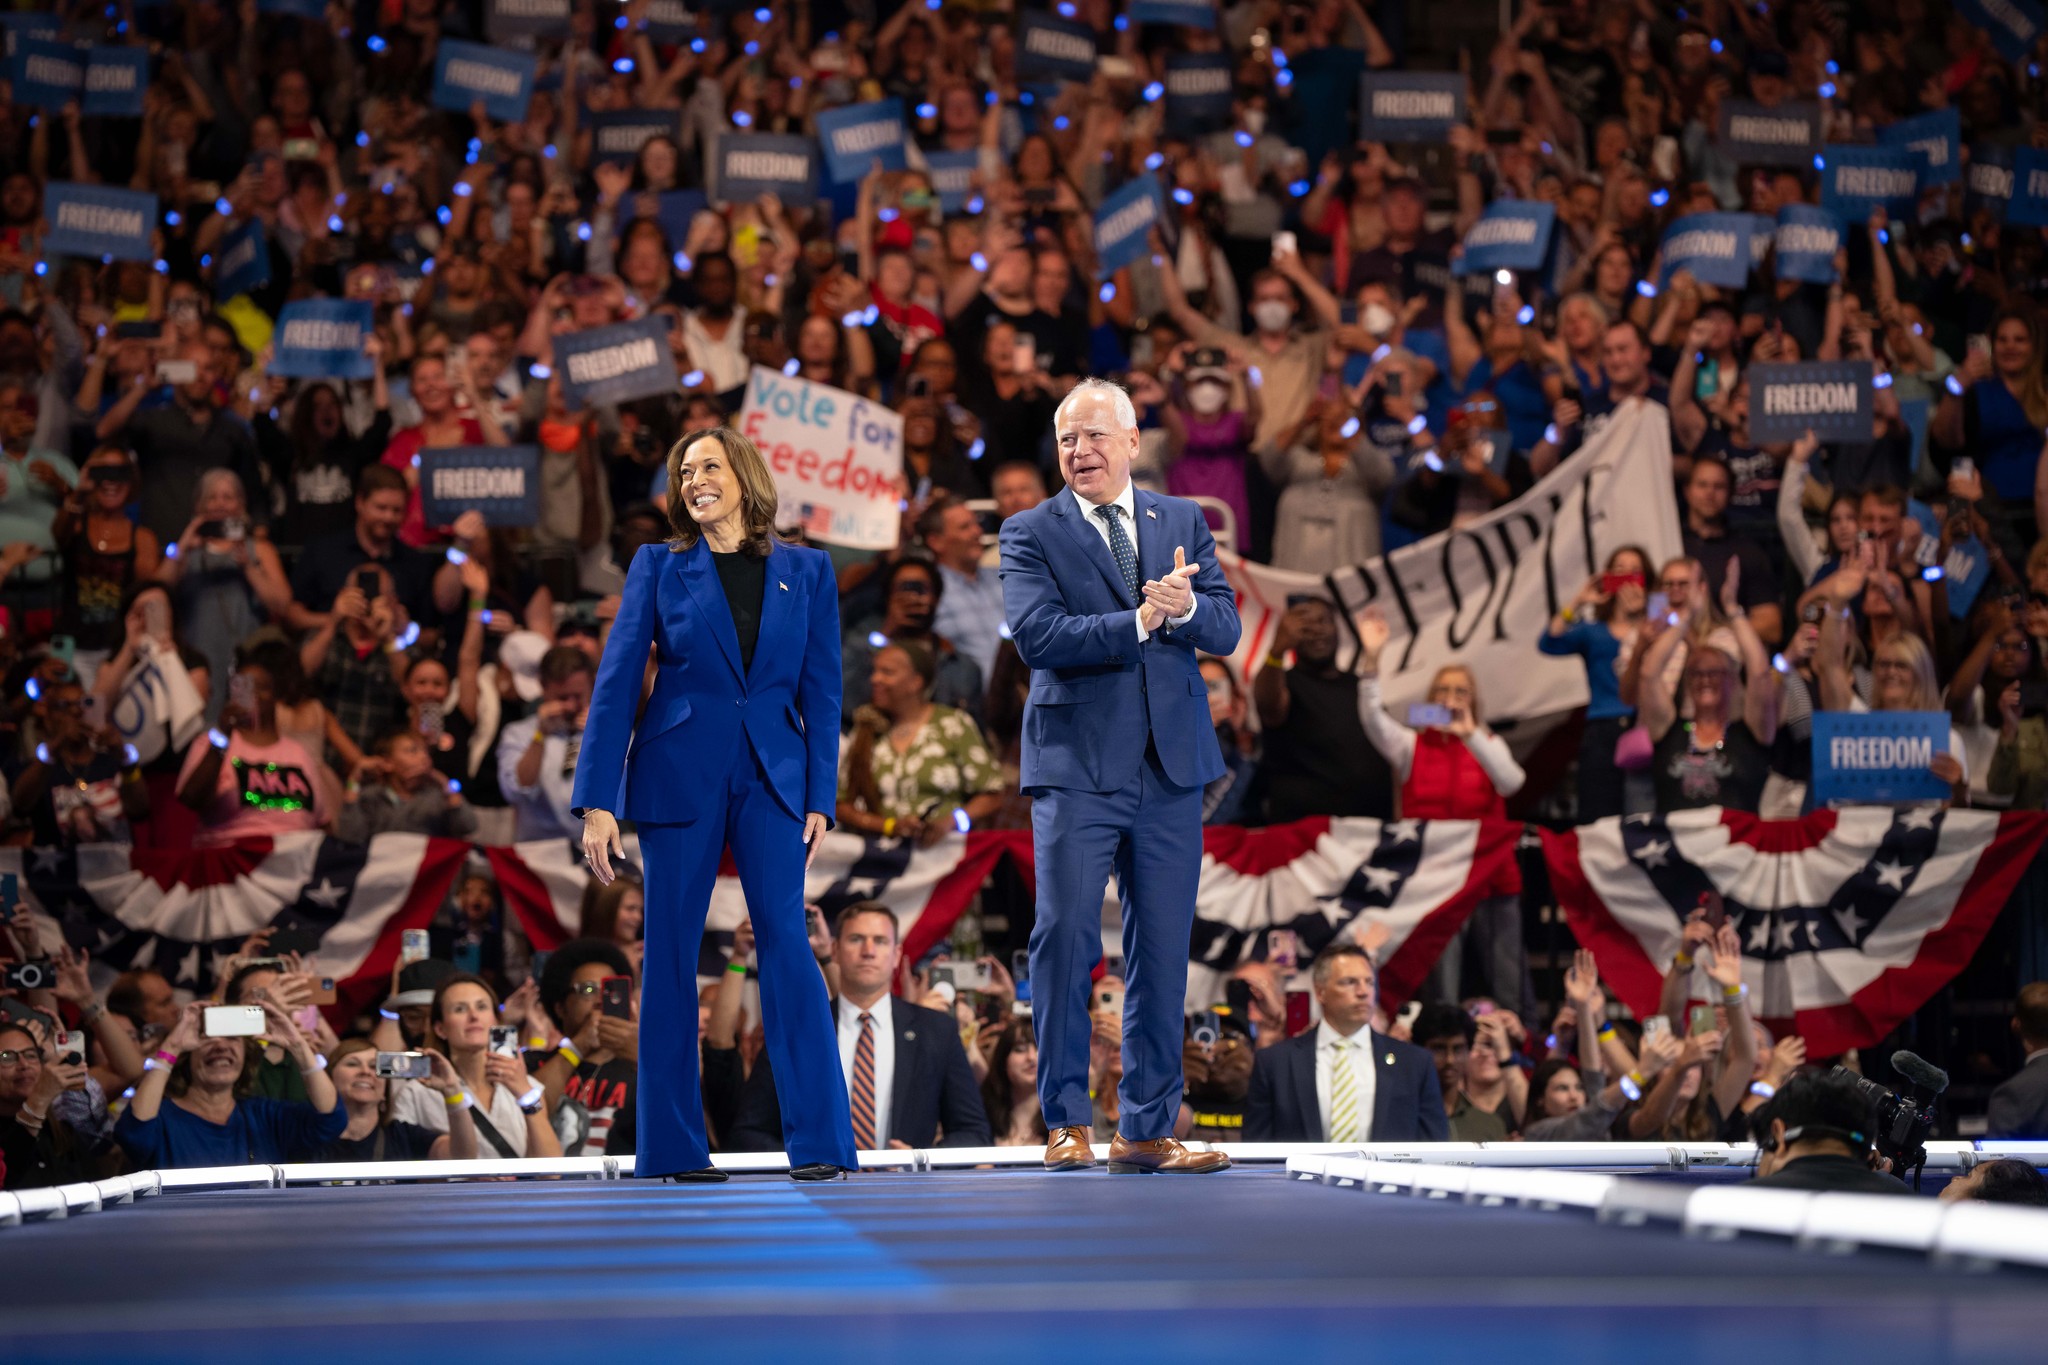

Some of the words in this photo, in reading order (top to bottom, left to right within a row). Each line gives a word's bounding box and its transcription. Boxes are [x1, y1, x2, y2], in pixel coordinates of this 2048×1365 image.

[1836, 166, 1917, 198] FREEDOM
[567, 338, 658, 384] FREEDOM
[754, 373, 835, 428] Vote
[1764, 384, 1857, 414] FREEDOM
[432, 467, 525, 499] FREEDOM
[1830, 736, 1931, 770] FREEDOM
